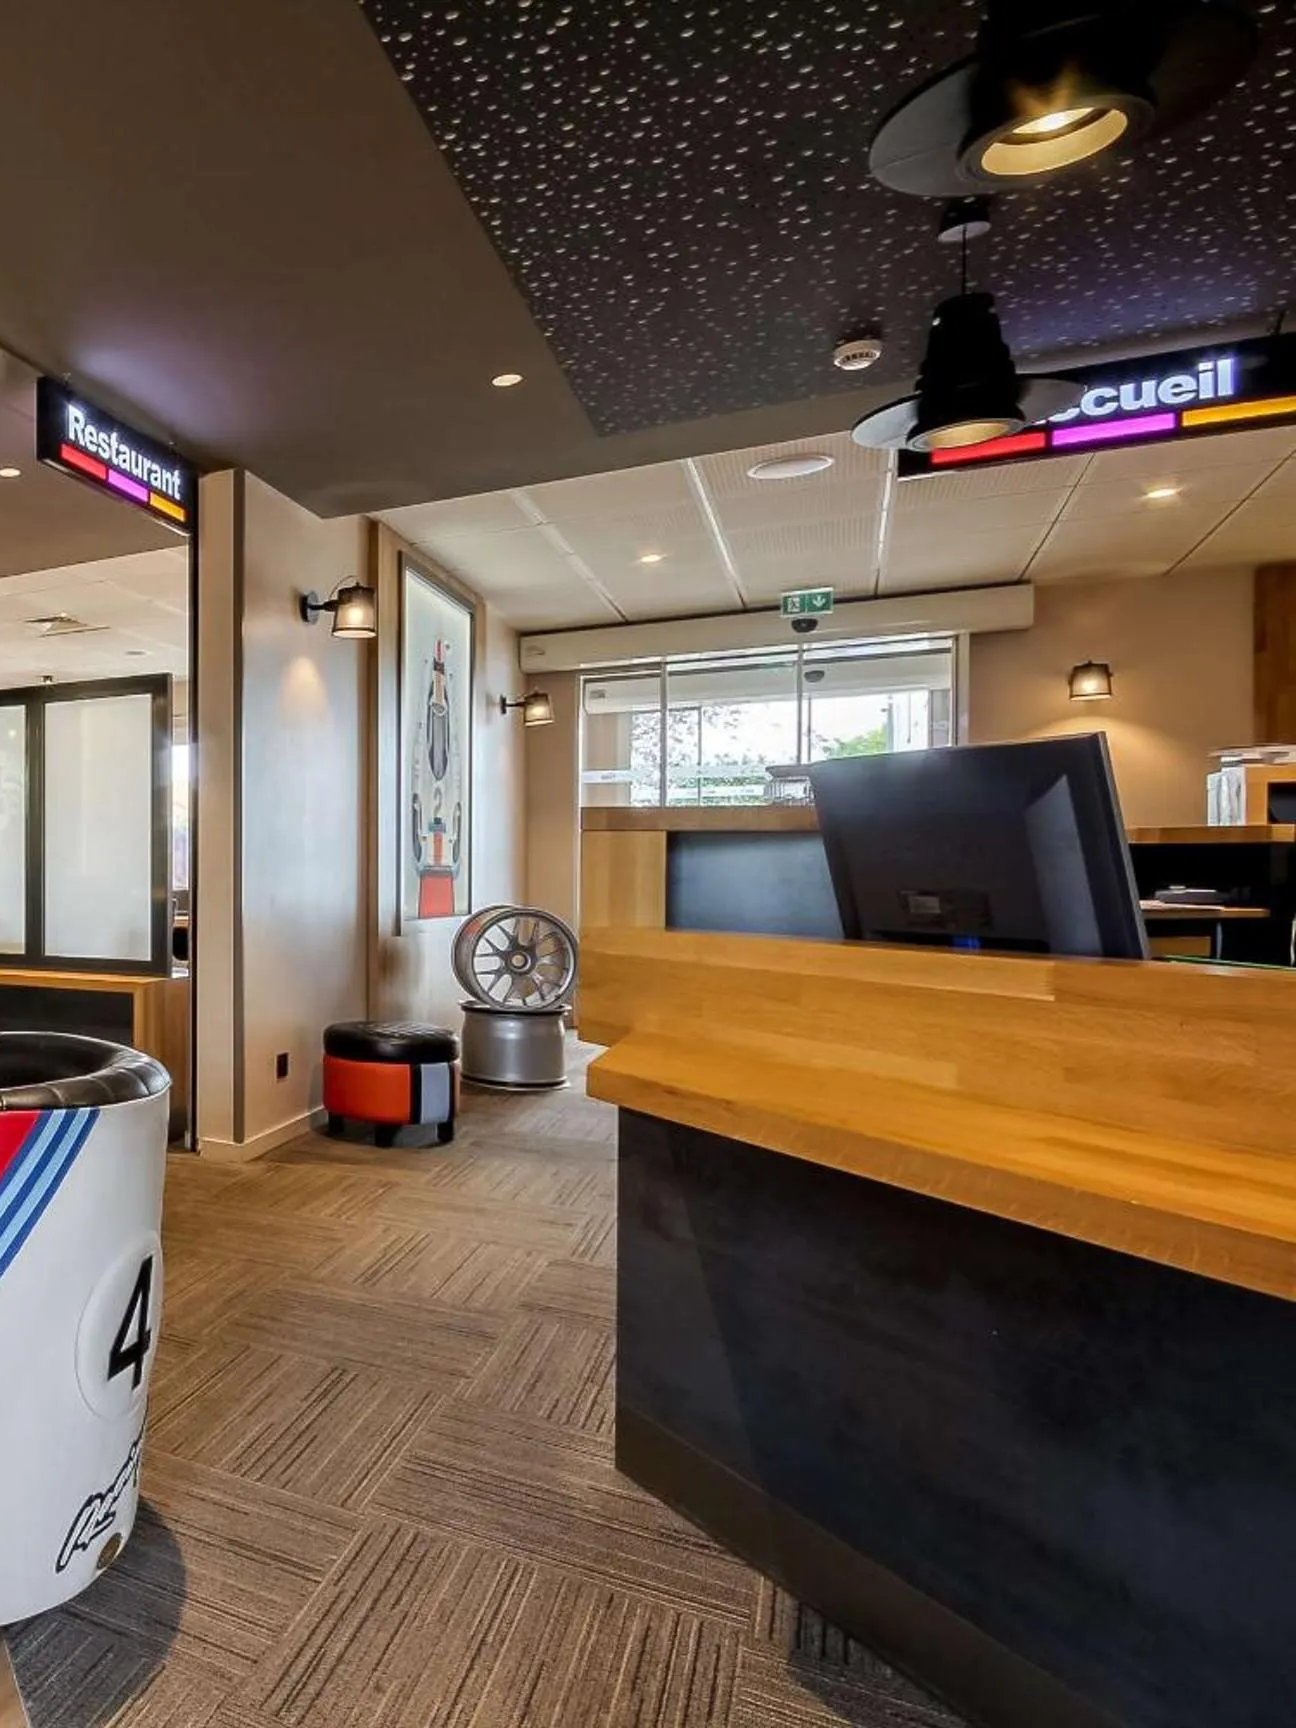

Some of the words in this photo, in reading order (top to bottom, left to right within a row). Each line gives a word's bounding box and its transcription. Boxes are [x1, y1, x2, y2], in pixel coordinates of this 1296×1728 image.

[1032, 356, 1235, 425] cueil
[67, 403, 182, 500] Restaurant
[106, 1254, 153, 1391] 4
